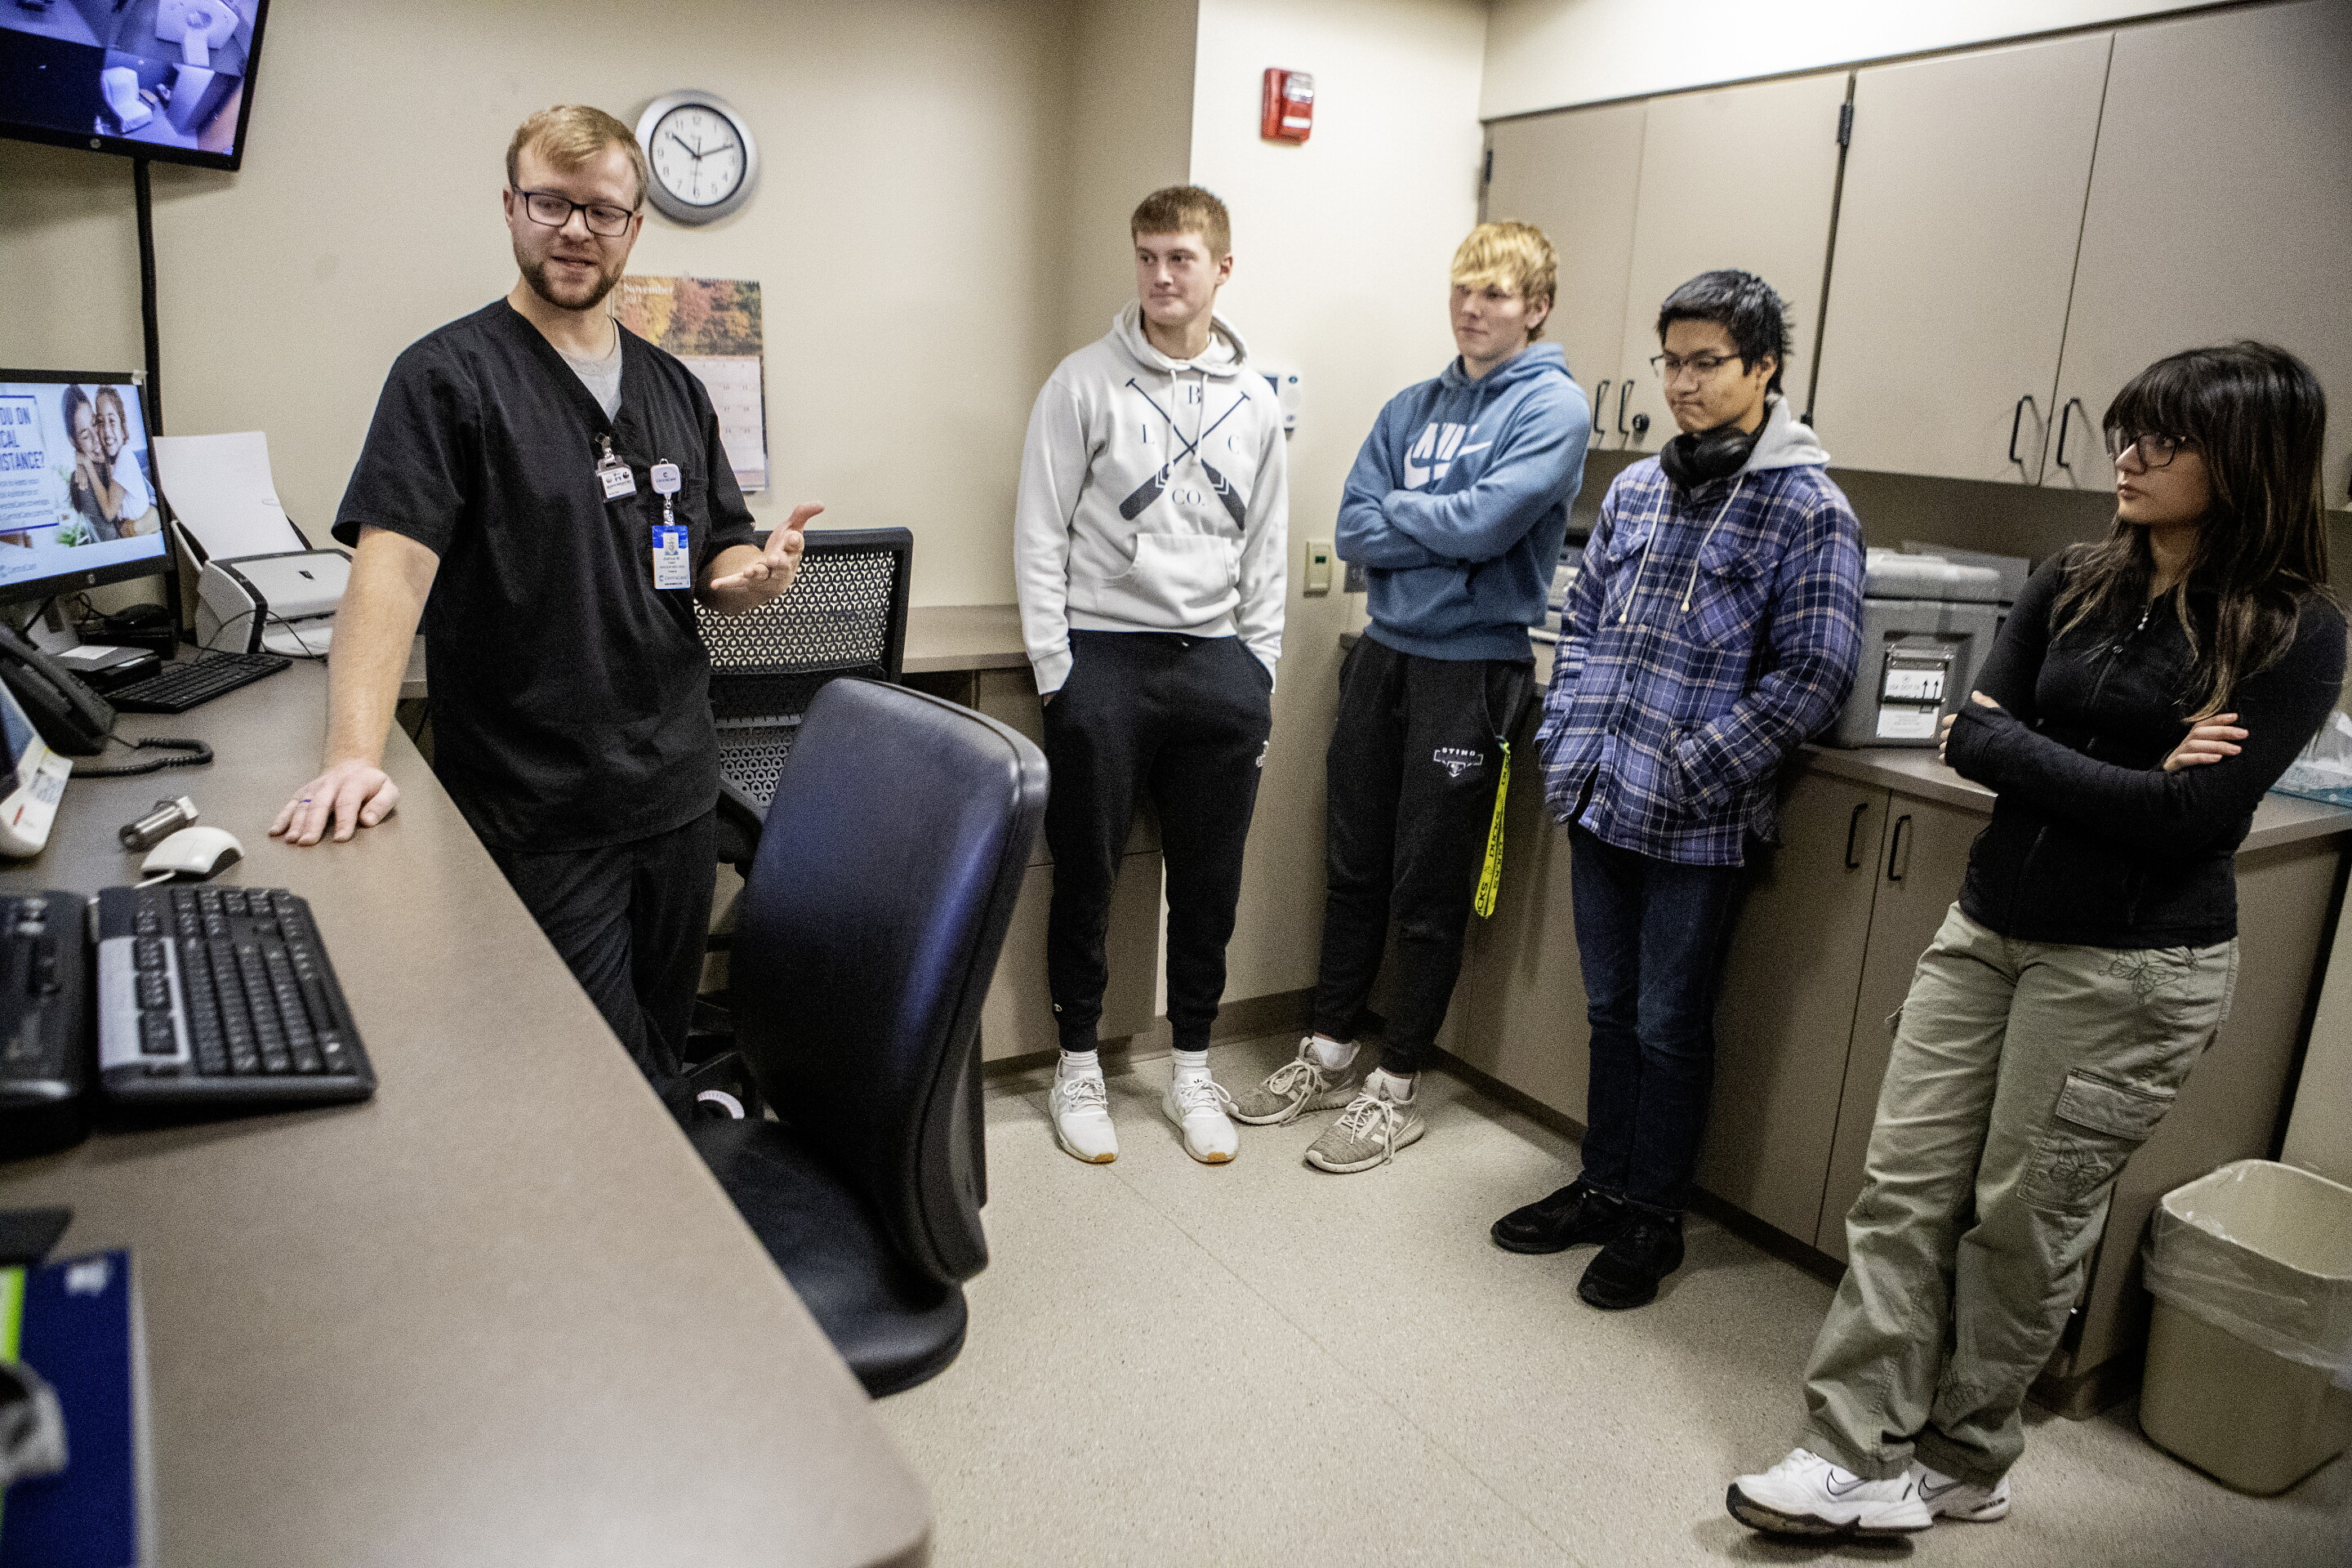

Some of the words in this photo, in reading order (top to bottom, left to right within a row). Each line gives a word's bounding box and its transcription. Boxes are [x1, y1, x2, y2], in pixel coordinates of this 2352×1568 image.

[623, 283, 674, 295] November
[1189, 384, 1201, 405] B
[16, 407, 32, 425] ON
[1143, 424, 1155, 445] L
[1227, 434, 1240, 455] C
[1172, 488, 1205, 506] CO.
[1477, 881, 1488, 914] CKS
